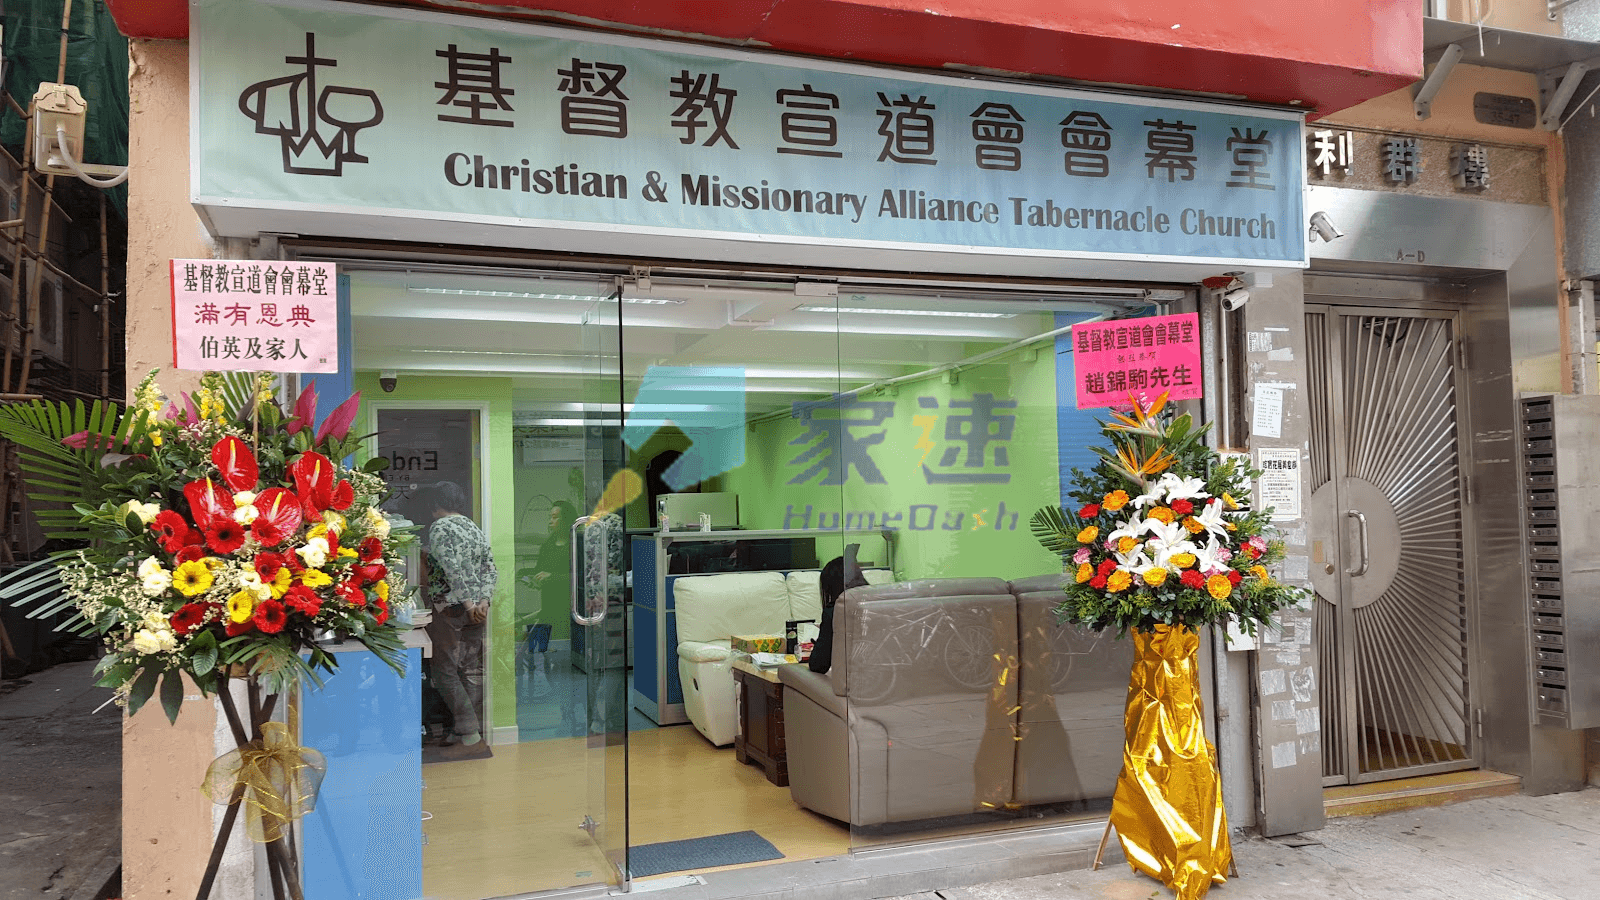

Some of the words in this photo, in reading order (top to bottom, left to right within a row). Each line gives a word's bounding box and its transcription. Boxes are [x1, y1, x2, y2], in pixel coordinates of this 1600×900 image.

[435, 44, 1276, 191] 基督教宣道會會幕堂
[1314, 129, 1490, 190] 利群樓
[444, 152, 628, 199] Christian
[642, 170, 669, 203] &
[681, 173, 868, 224] Missionary
[878, 188, 999, 224] Alliance
[1008, 196, 1170, 234] Tabernacle
[1180, 207, 1276, 240] Church
[1397, 248, 1426, 263] A-D
[183, 263, 328, 297] 基督教宣道會會幕堂
[194, 302, 316, 328] 滿有恩典
[199, 335, 309, 361] 伯英及家人
[1077, 320, 1194, 353] 基督教宣道會會幕堂
[1084, 364, 1193, 394] 趙錦駒先生
